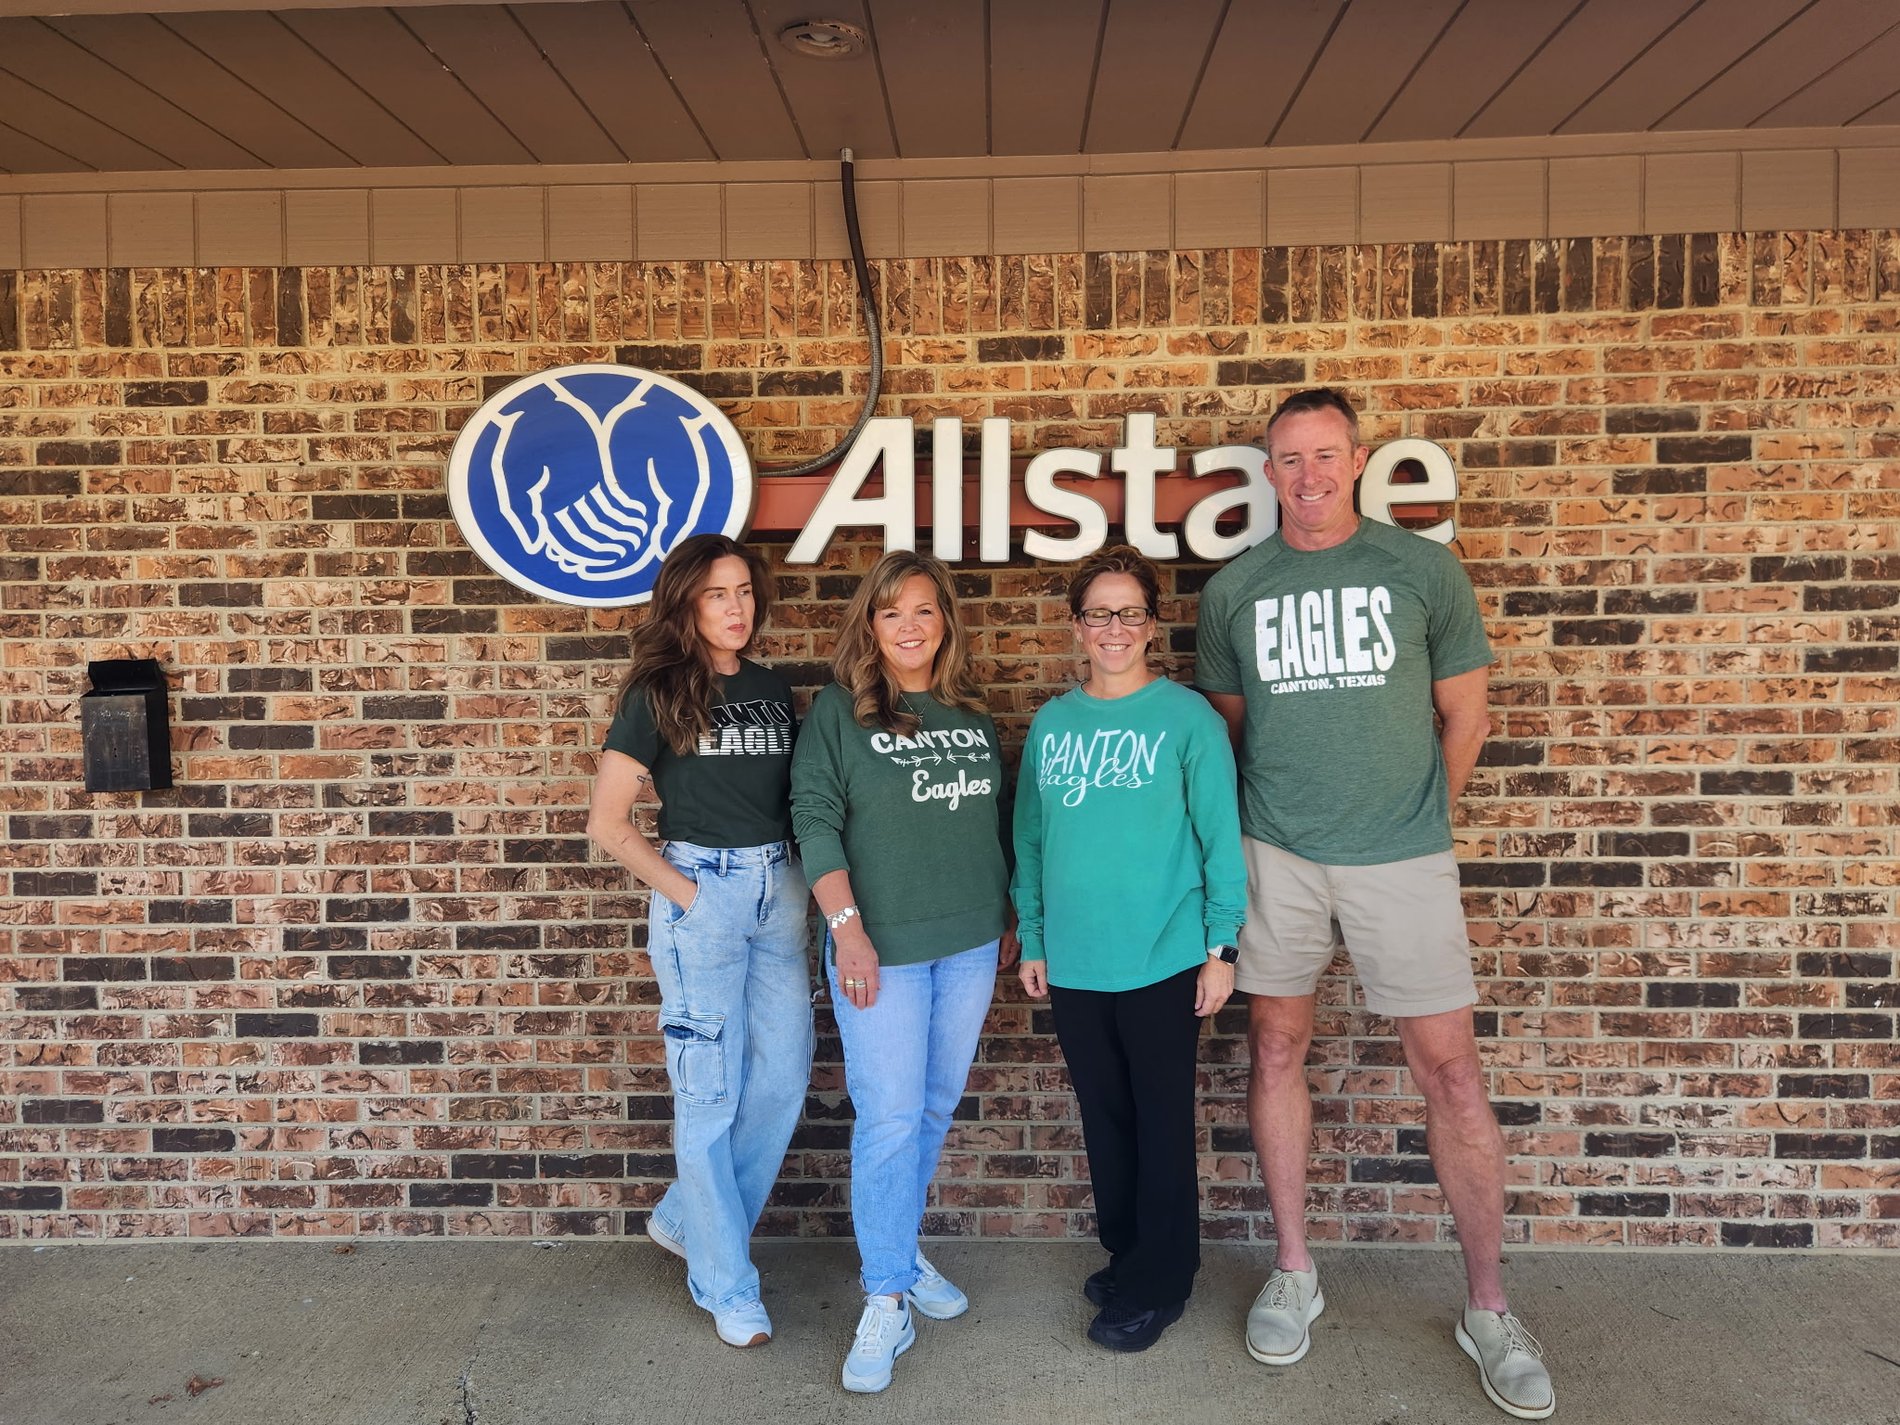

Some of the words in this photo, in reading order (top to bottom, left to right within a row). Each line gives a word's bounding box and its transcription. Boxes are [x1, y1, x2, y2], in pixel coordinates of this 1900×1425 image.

[784, 411, 1458, 564] Allstae
[1255, 586, 1396, 681] EAGLES
[1270, 677, 1334, 695] CANTON,
[1336, 674, 1386, 689] TEXAS
[870, 728, 990, 754] CANTON
[1040, 728, 1166, 777] CANTON
[911, 769, 992, 811] Eagles
